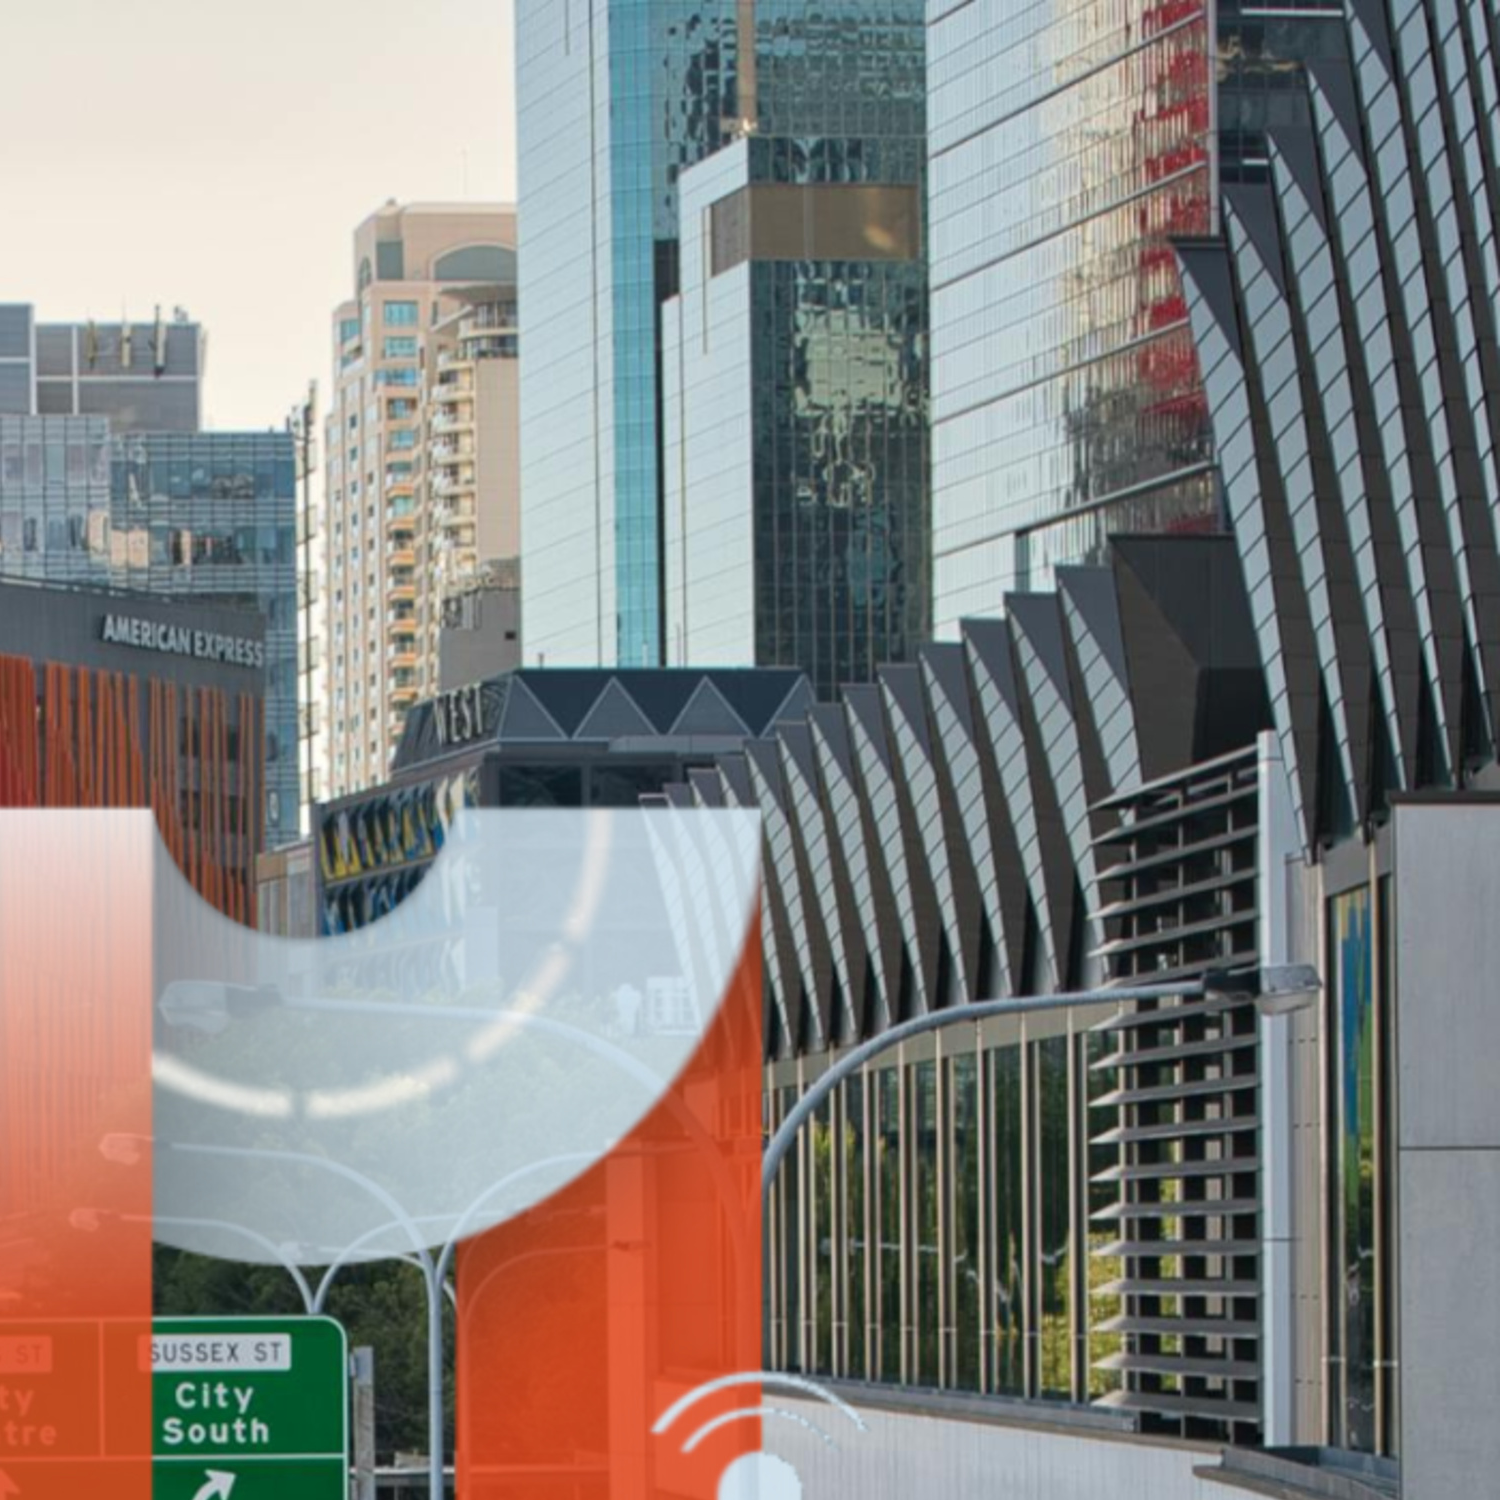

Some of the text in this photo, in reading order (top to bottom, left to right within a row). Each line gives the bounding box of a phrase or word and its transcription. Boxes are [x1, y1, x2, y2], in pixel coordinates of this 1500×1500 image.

[102, 614, 263, 667] AMERICAN EXPRESS
[16, 1344, 43, 1364] ST
[148, 1342, 282, 1363] SUSSEX ST
[175, 1382, 254, 1413] City
[162, 1417, 269, 1444] South
